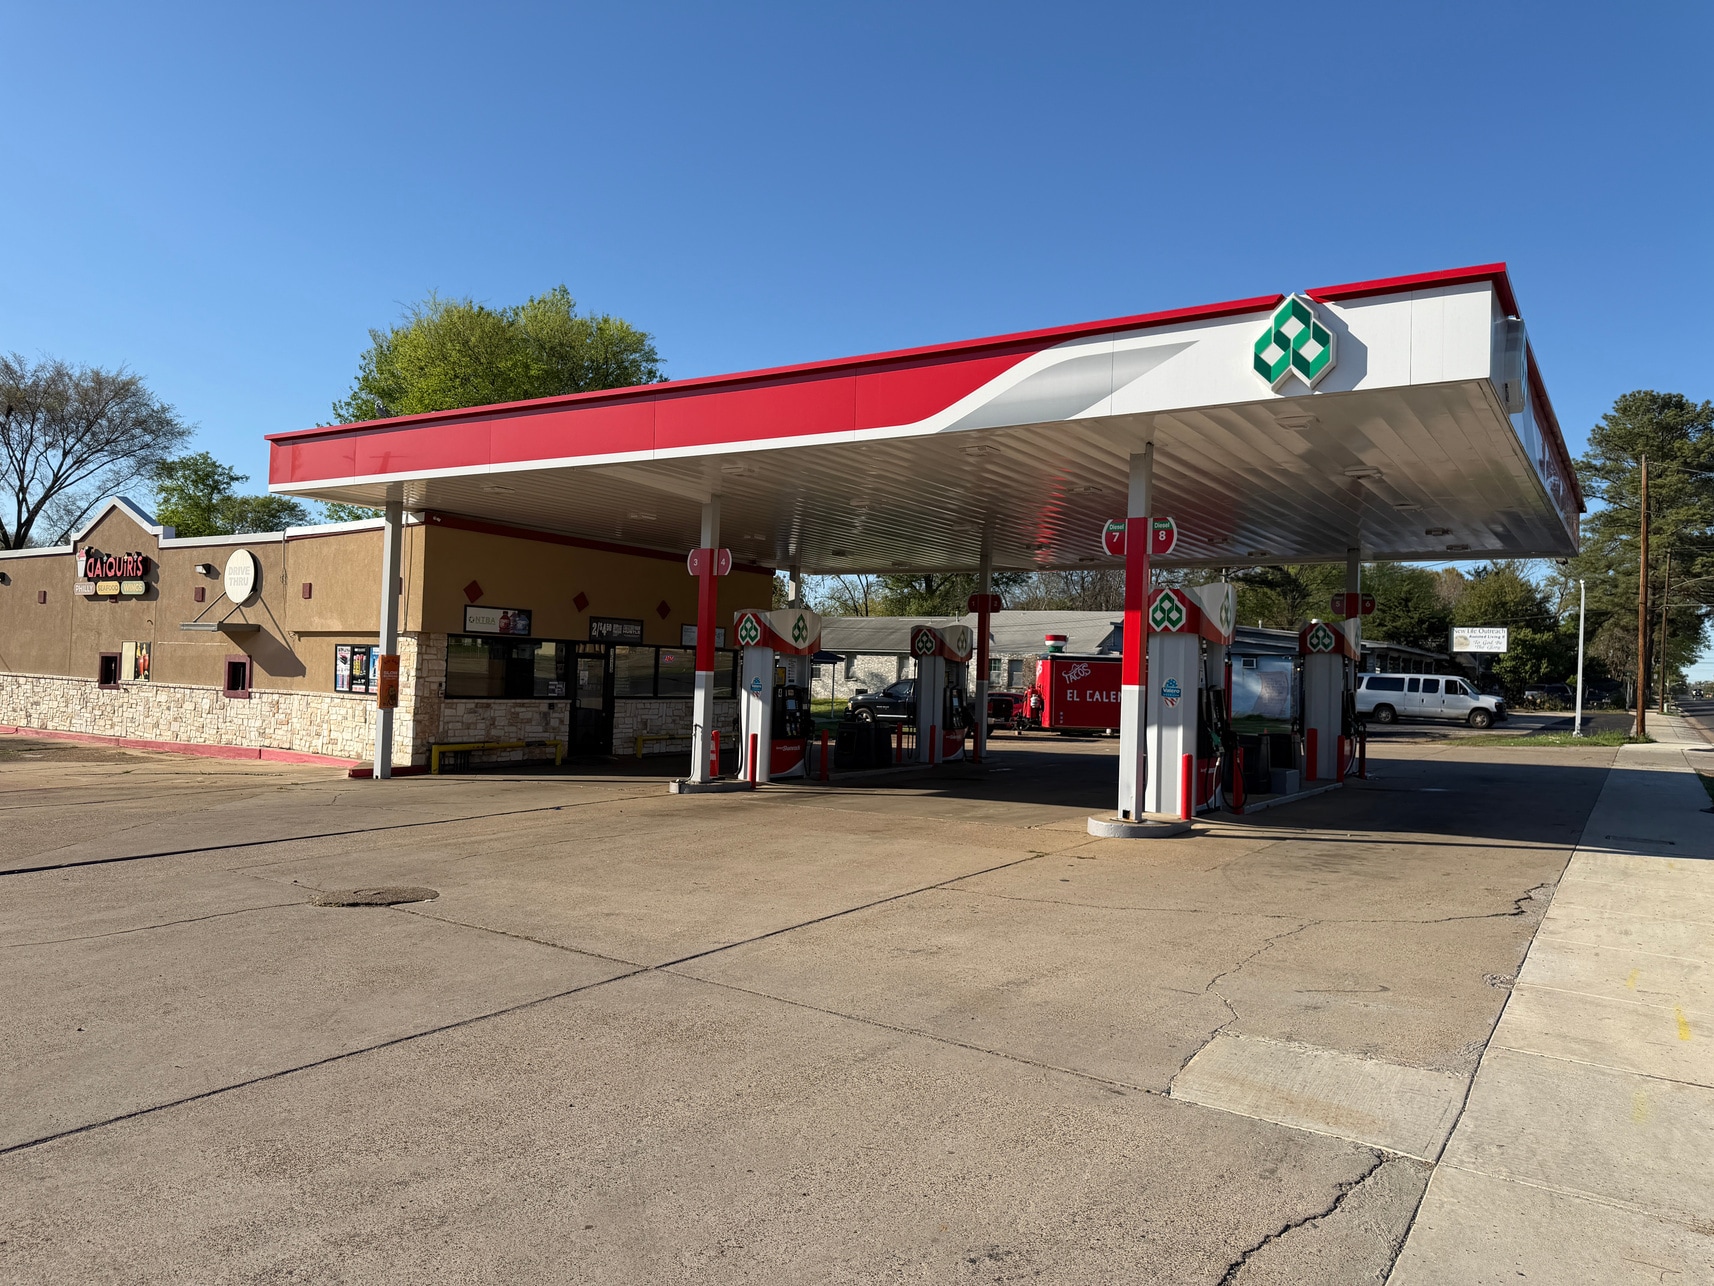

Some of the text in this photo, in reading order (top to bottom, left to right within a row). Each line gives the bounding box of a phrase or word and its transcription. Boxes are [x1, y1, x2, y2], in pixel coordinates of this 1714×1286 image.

[1154, 521, 1170, 529] Diesel
[1112, 532, 1119, 542] 7
[1158, 530, 1166, 541] 8
[693, 558, 698, 566] 3
[720, 558, 726, 566] 4
[228, 566, 251, 576] DRIVE
[228, 576, 249, 587] THRU
[75, 584, 94, 593] PHILLY
[97, 584, 119, 592] SEAFOOD
[123, 583, 143, 592] WINGS
[1062, 663, 1091, 684] TACOS
[1067, 689, 1080, 702] EL
